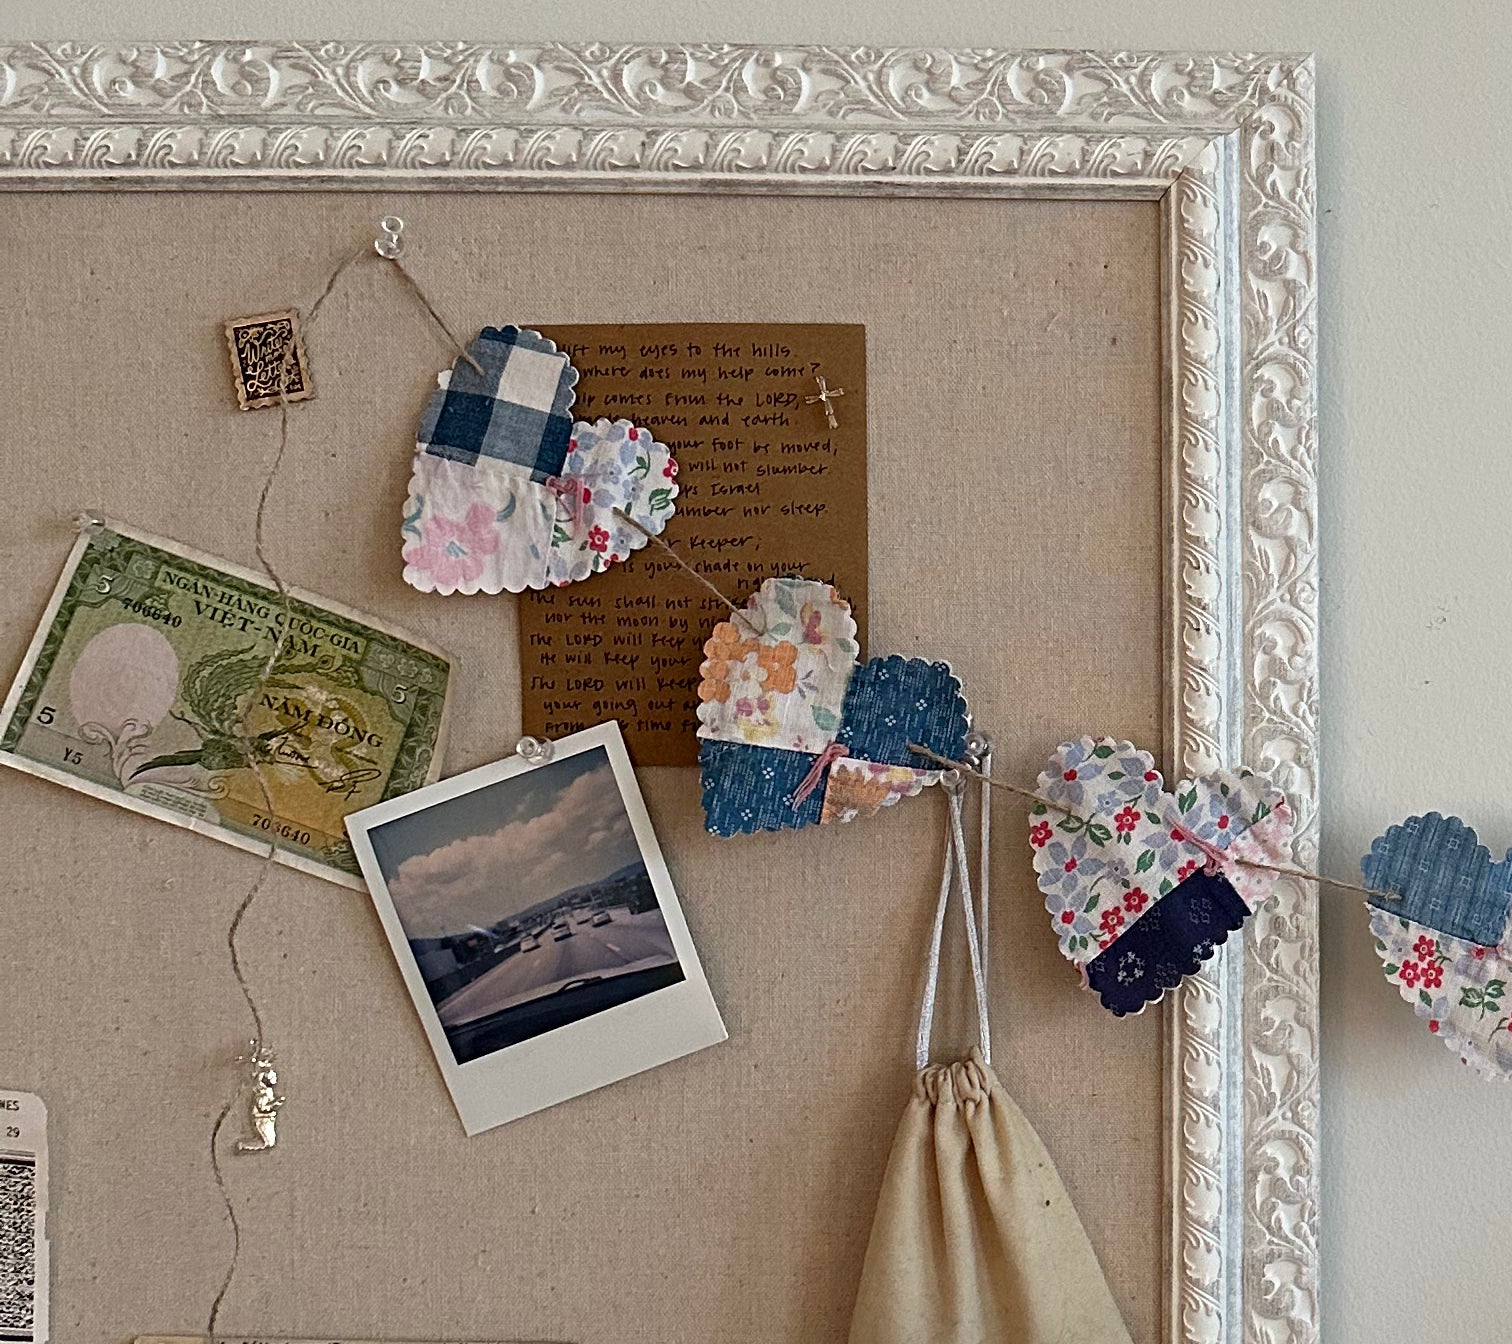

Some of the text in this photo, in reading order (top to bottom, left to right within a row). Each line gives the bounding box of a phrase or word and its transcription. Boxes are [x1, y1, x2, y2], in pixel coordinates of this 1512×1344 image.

[600, 345, 625, 359] my
[640, 344, 677, 359] eyes
[687, 342, 701, 356] to
[713, 343, 740, 356] the
[583, 363, 820, 383] where does my help come?
[604, 393, 650, 405] comes
[717, 393, 743, 405] the
[632, 413, 687, 426] heaven
[699, 413, 729, 425] and
[753, 441, 770, 454] be
[689, 460, 716, 471] will
[724, 461, 748, 472] not
[711, 483, 759, 496] Israel
[744, 506, 770, 517] nor
[694, 561, 738, 572] shade
[748, 562, 763, 572] on
[771, 562, 810, 577] your
[95, 575, 113, 594] 5
[530, 593, 555, 604] The
[569, 596, 600, 607] sun
[615, 596, 655, 610] shall
[666, 598, 692, 609] not
[545, 613, 571, 623] nor
[580, 613, 605, 625] the
[617, 617, 658, 627] moon
[669, 616, 687, 633] by
[530, 634, 552, 646] The
[566, 635, 603, 646] LORD
[614, 634, 642, 646] will
[540, 652, 556, 665] He
[566, 651, 592, 664] will
[651, 658, 692, 674] your
[531, 677, 555, 690] The
[567, 677, 604, 691] LORD
[616, 677, 645, 691] will
[390, 684, 408, 704] 5
[37, 707, 56, 724] 5
[544, 701, 582, 714] your
[593, 699, 637, 716] going
[648, 699, 676, 710] out
[637, 721, 671, 731] time
[63, 747, 84, 765] Y5
[7, 1126, 19, 1137] 29
